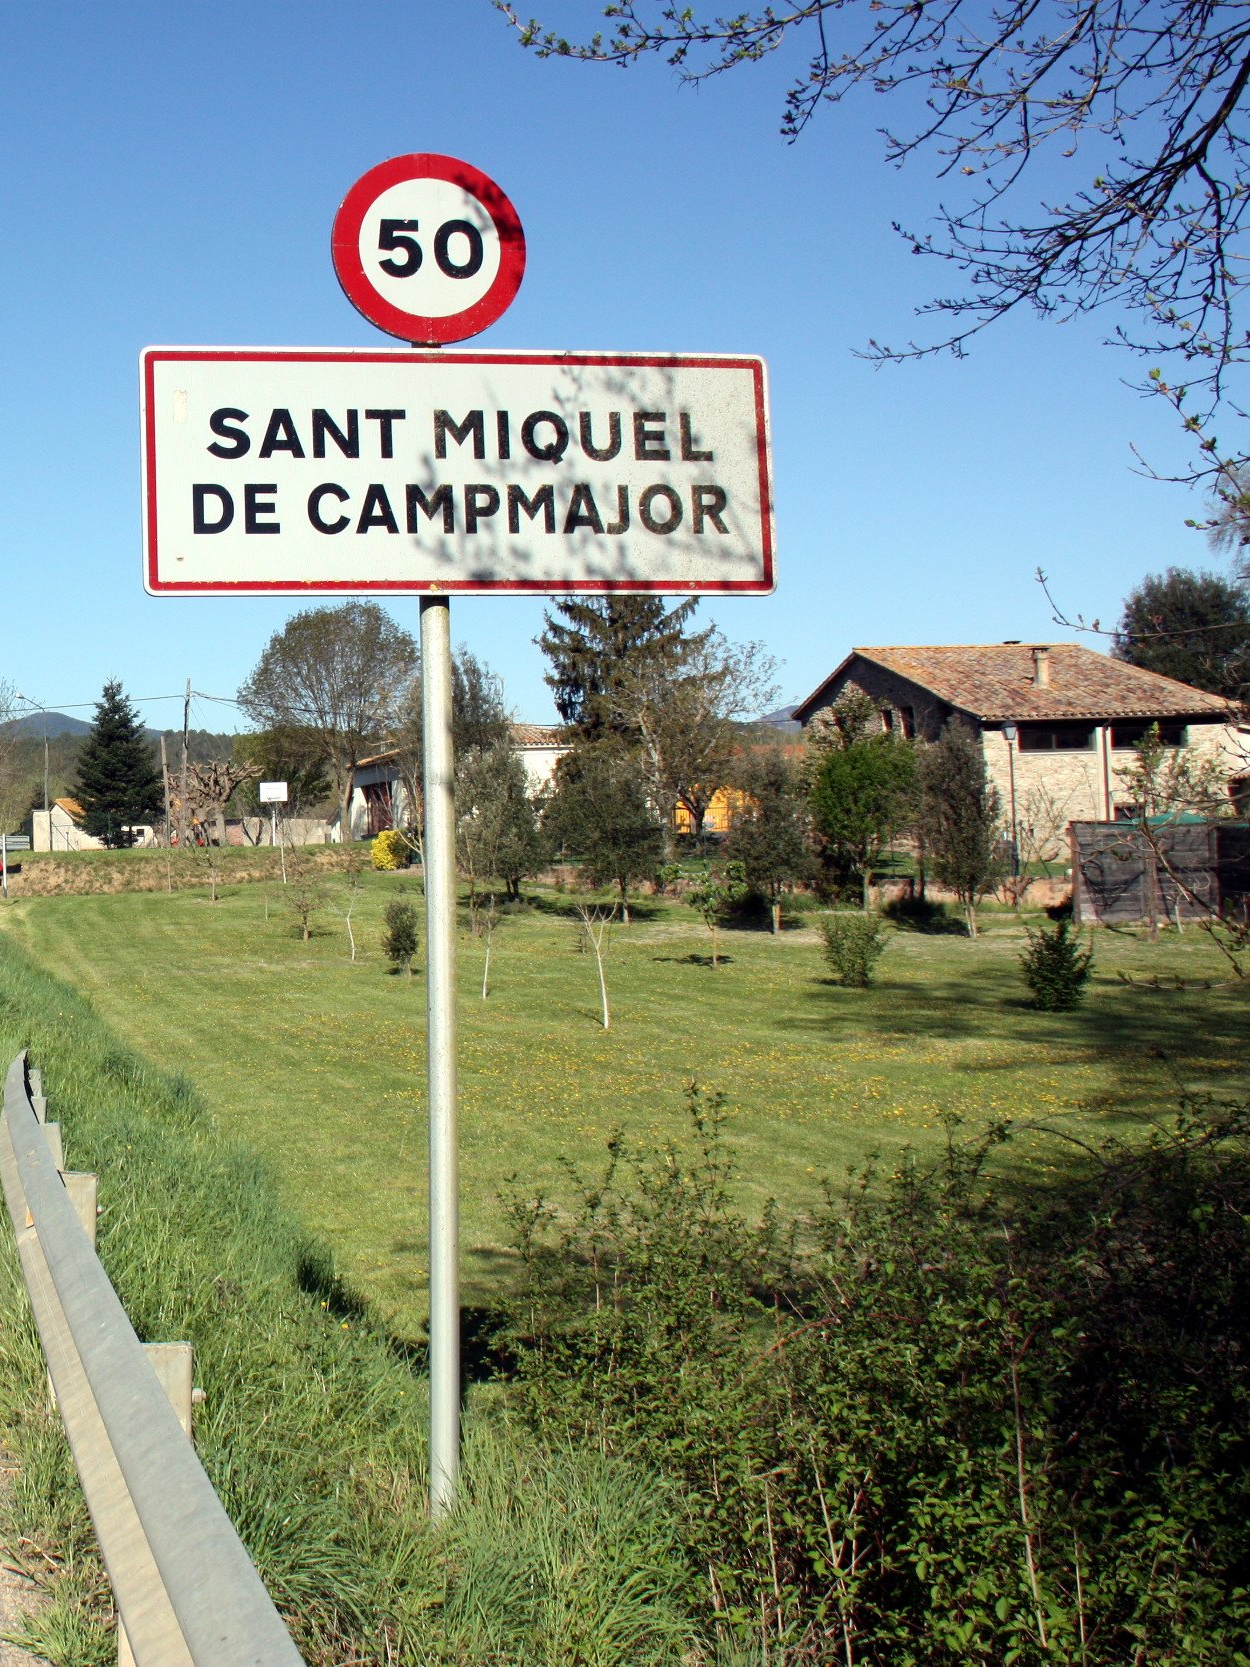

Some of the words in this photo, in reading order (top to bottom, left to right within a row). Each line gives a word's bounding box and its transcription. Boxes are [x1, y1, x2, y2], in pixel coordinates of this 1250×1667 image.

[378, 218, 484, 280] 50
[206, 407, 406, 460] SANT
[434, 409, 714, 465] MIQUEL
[192, 483, 281, 535] DE
[307, 483, 730, 535] CAMPMAJOR
